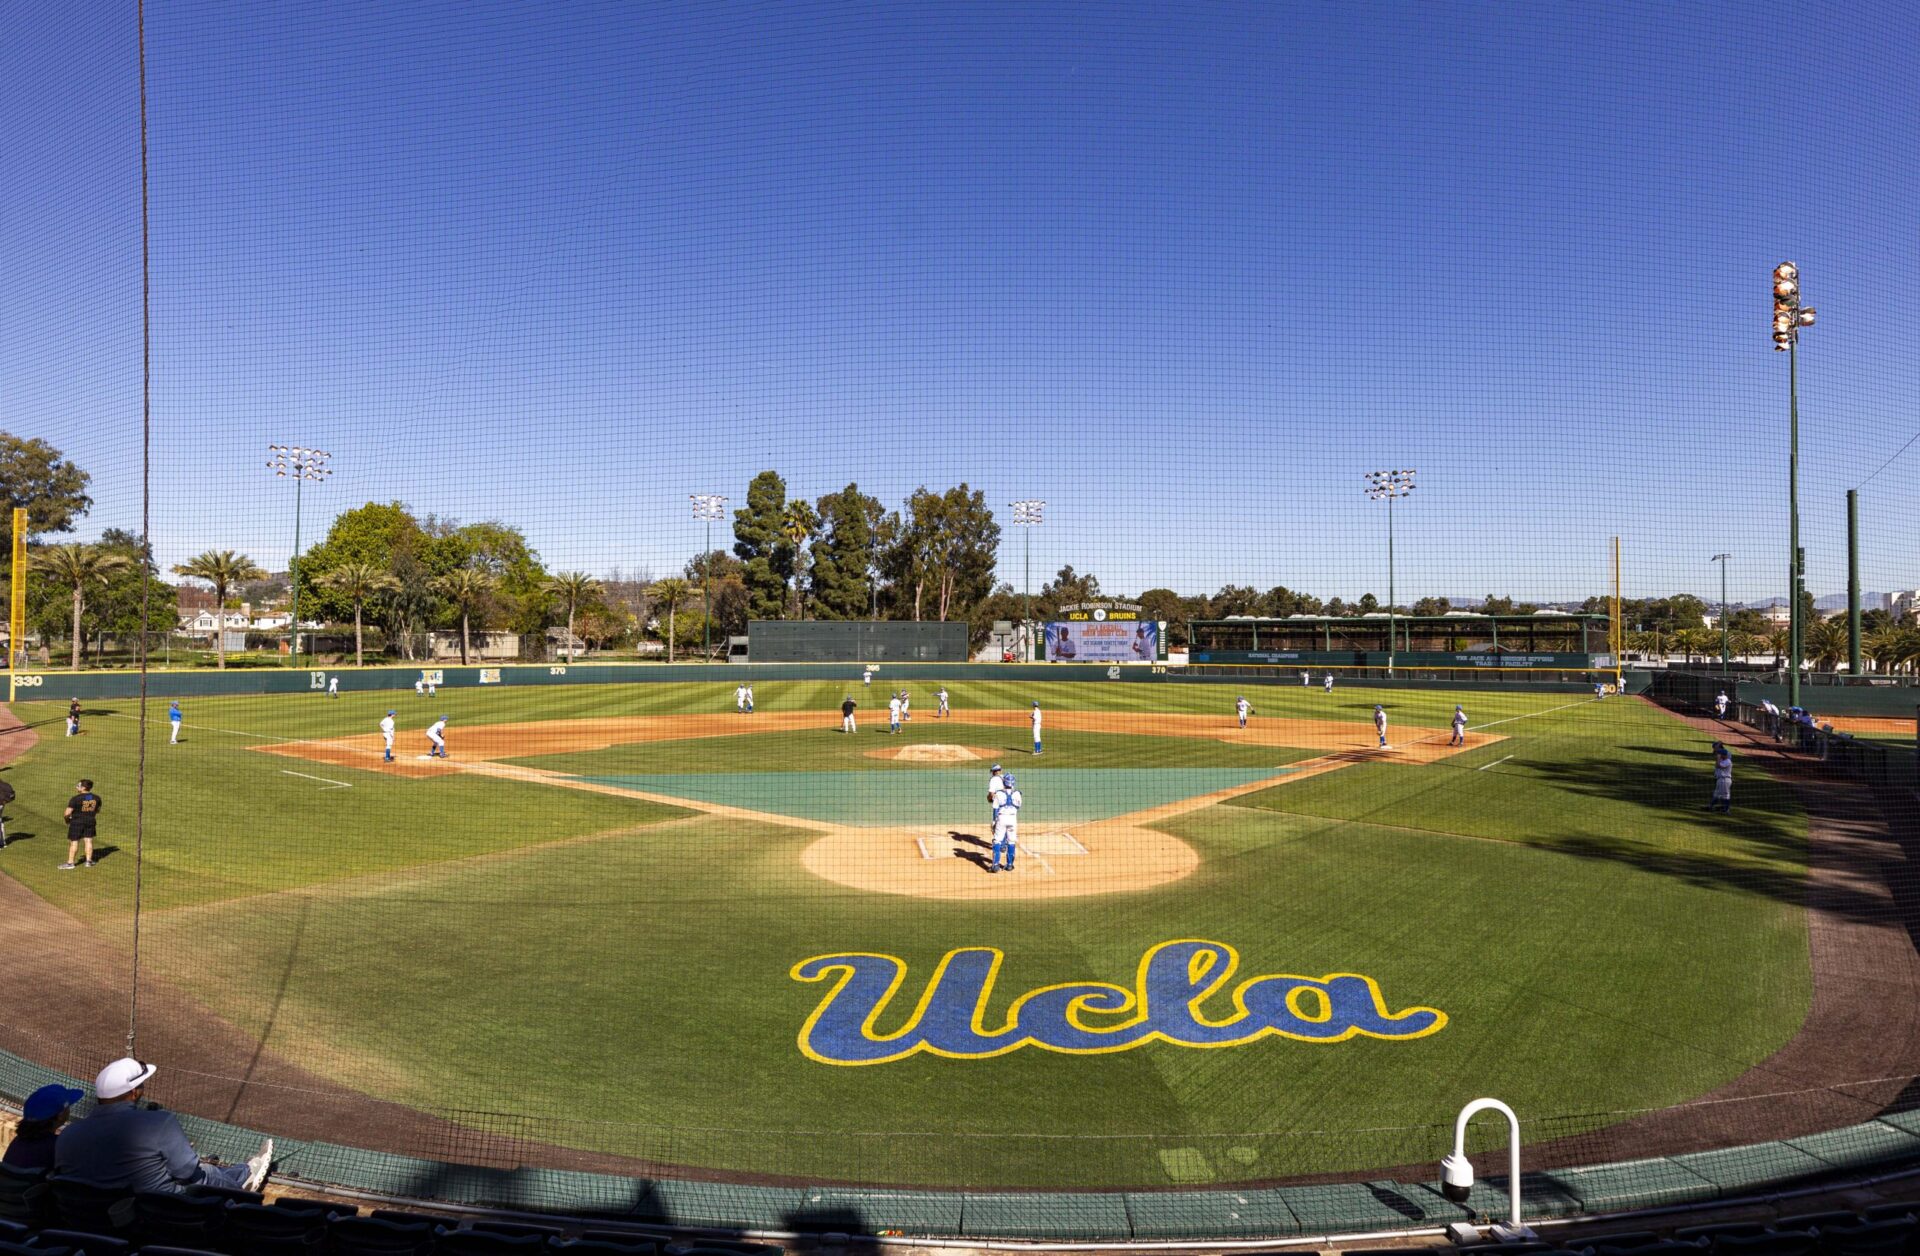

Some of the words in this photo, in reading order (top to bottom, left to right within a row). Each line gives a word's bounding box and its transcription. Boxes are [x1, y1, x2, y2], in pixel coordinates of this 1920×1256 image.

[1059, 604, 1080, 613] JACKIE
[1081, 602, 1112, 610] ROBINSON
[1114, 602, 1142, 612] STADIUM
[1109, 612, 1136, 620] BRUINS
[550, 667, 565, 675] 370
[1107, 666, 1120, 678] 42
[1151, 666, 1166, 674] 370
[15, 676, 43, 686] 330
[310, 672, 325, 688] 13
[1602, 684, 1617, 693] 30
